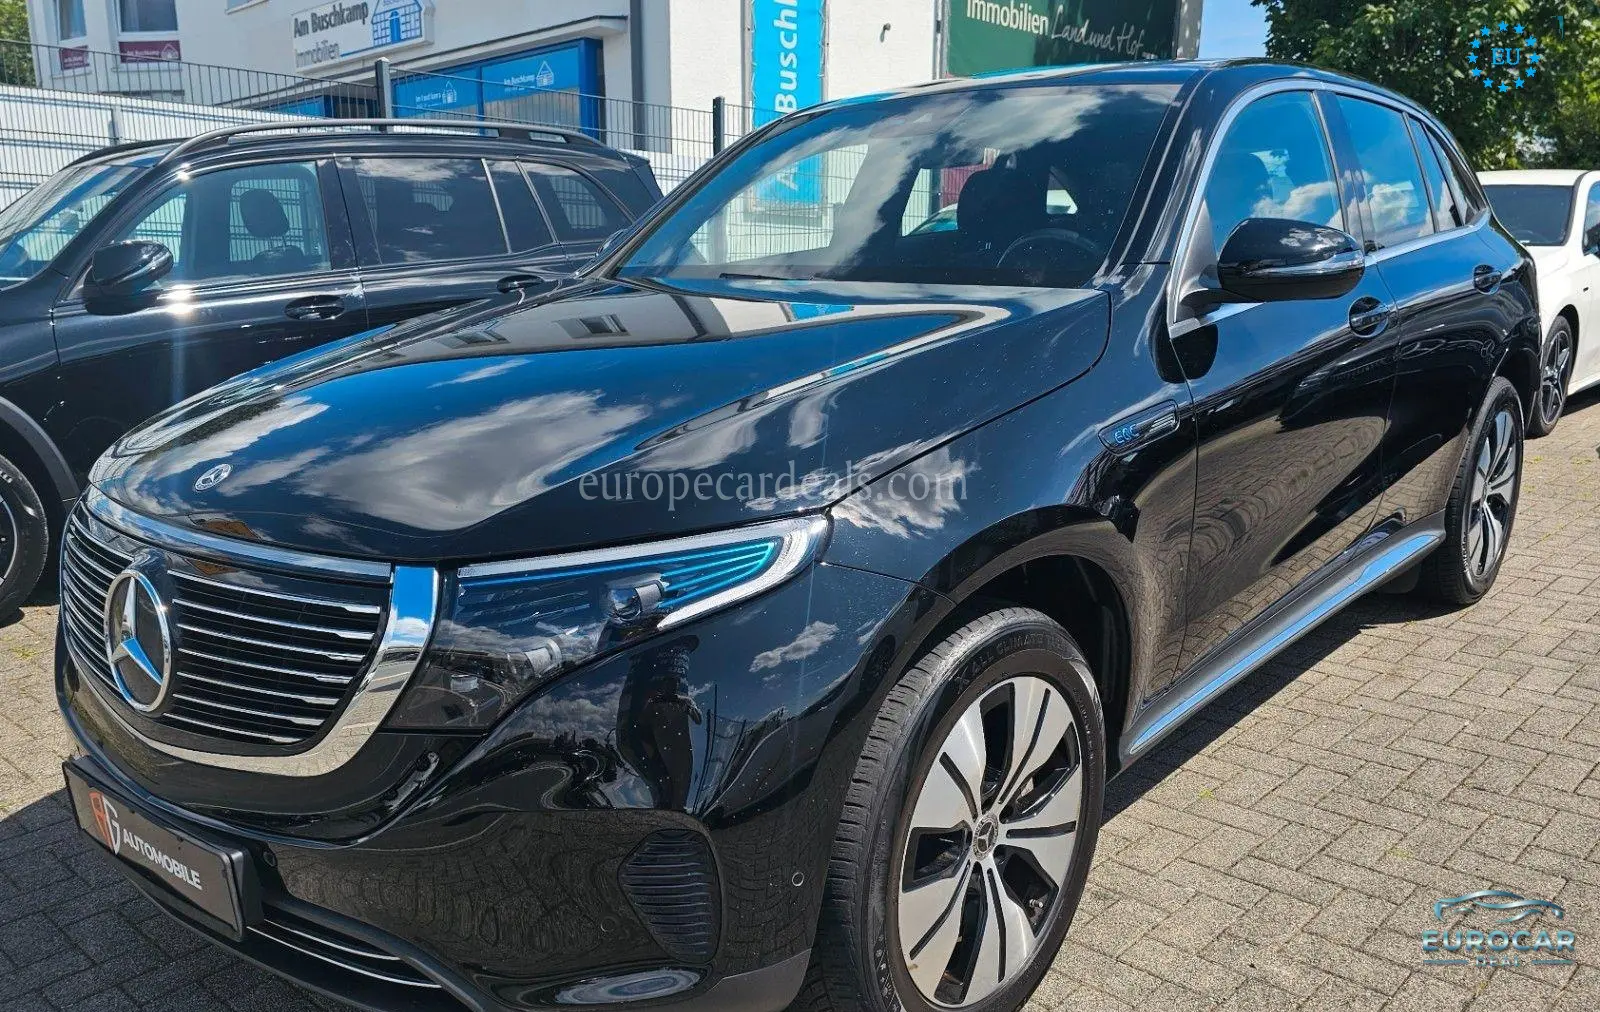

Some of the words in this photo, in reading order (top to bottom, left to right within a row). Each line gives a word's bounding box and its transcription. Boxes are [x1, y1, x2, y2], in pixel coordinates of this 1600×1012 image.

[294, 18, 309, 38] Am
[310, 2, 369, 33] Buschkamp
[1051, 4, 1089, 45] Land
[1087, 26, 1115, 51] und
[1117, 22, 1145, 60] Hof
[773, 0, 798, 114] Busch
[122, 828, 203, 891] AUTOMOBILE
